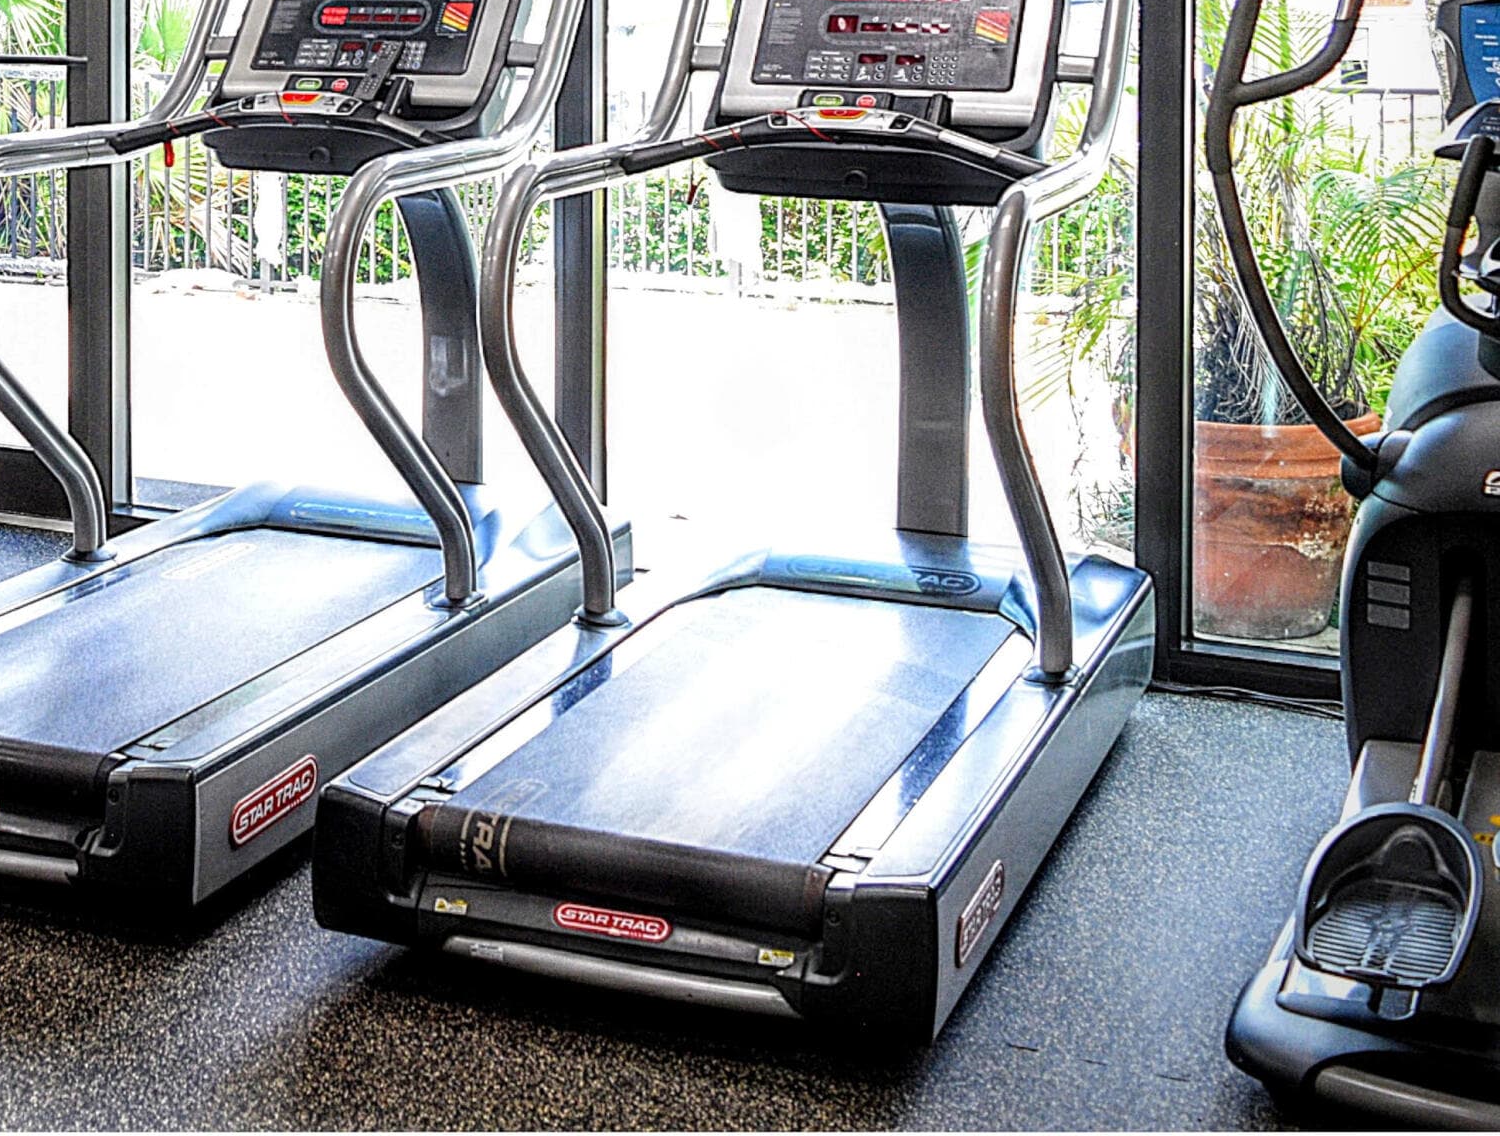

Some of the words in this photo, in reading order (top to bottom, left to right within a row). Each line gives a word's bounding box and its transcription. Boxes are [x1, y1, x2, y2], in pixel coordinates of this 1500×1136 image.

[236, 794, 274, 835] STAR
[275, 770, 312, 808] TRAC
[560, 909, 609, 925] STAR
[611, 916, 660, 933] TRAC
